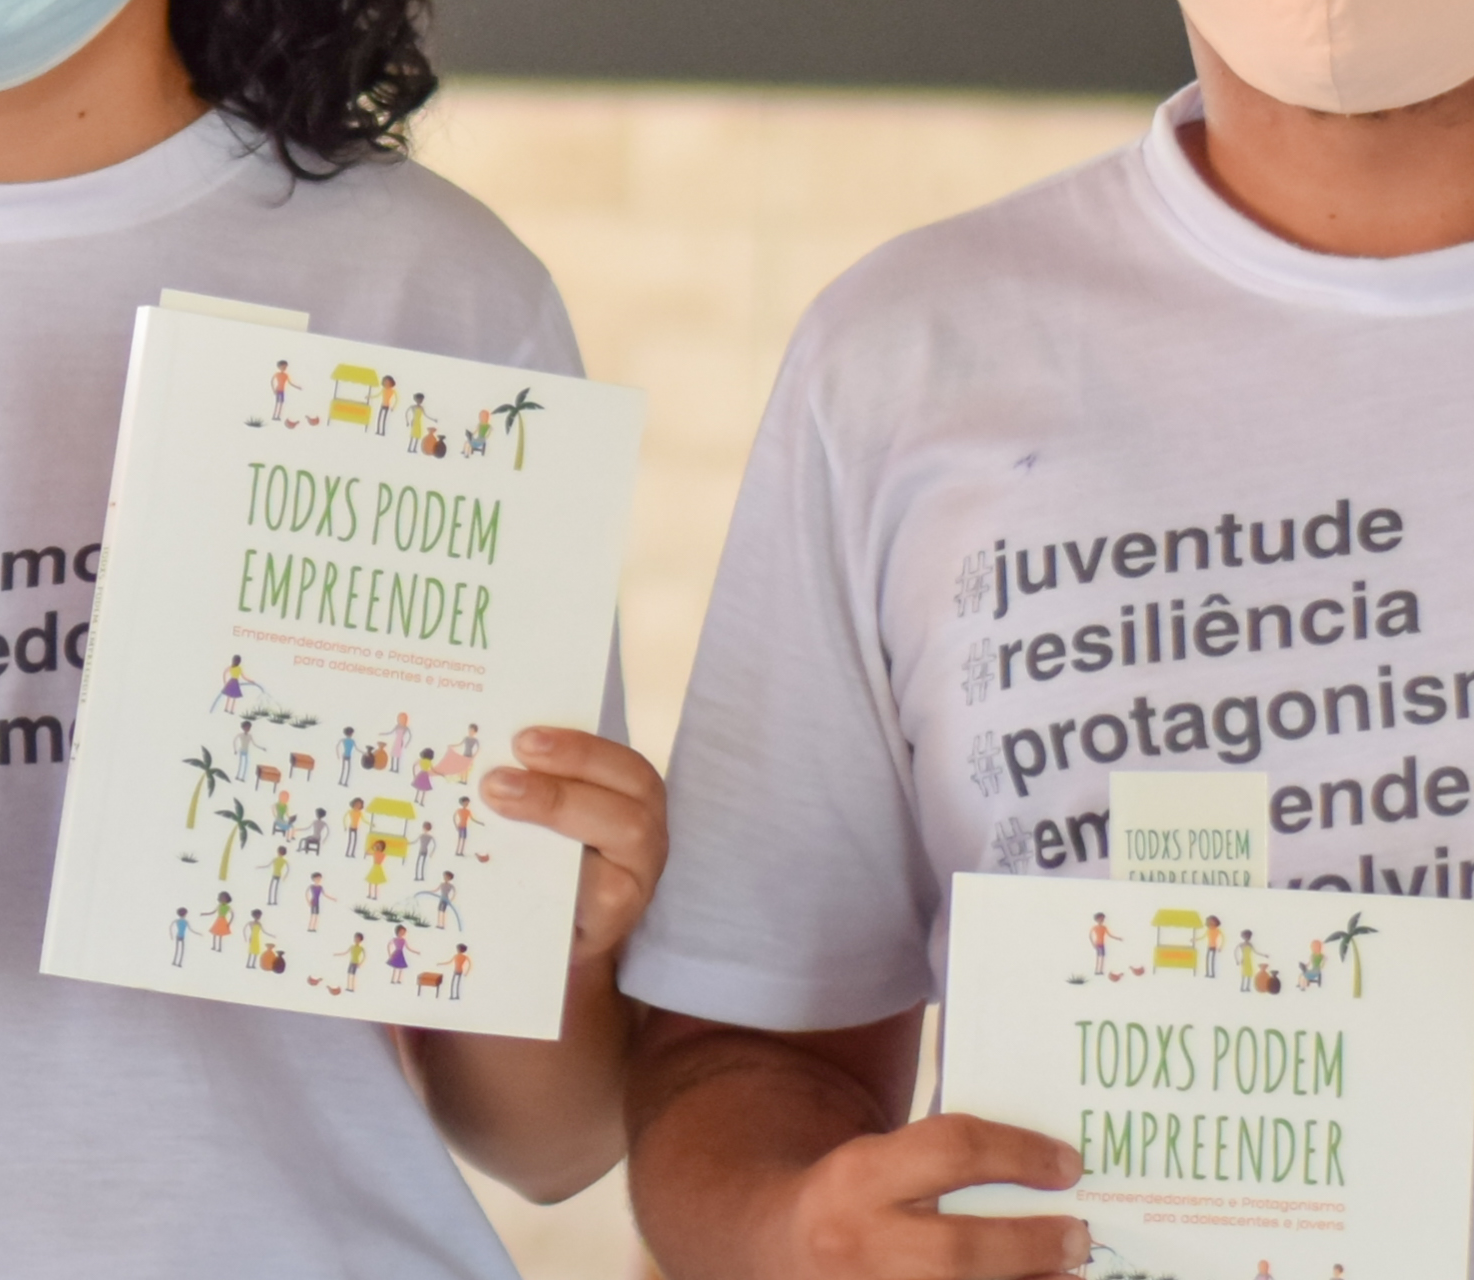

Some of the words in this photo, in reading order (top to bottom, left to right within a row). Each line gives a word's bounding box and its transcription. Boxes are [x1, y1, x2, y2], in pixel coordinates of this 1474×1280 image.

[246, 462, 361, 543] TODXS
[371, 482, 501, 566] PODEM
[237, 548, 490, 651] EMPREENDER
[232, 625, 372, 658] Empreendedorismo
[374, 649, 384, 659] e
[387, 649, 487, 676] Protagonismo
[328, 657, 423, 684] adolescentes
[425, 675, 435, 686] e
[436, 675, 484, 694] jovens
[1124, 828, 1182, 861] TODXS
[1187, 828, 1251, 861] PODEM
[1074, 1019, 1196, 1092] TODXS
[1212, 1024, 1344, 1099] PODEM
[1079, 1108, 1346, 1188] EMPREENDER
